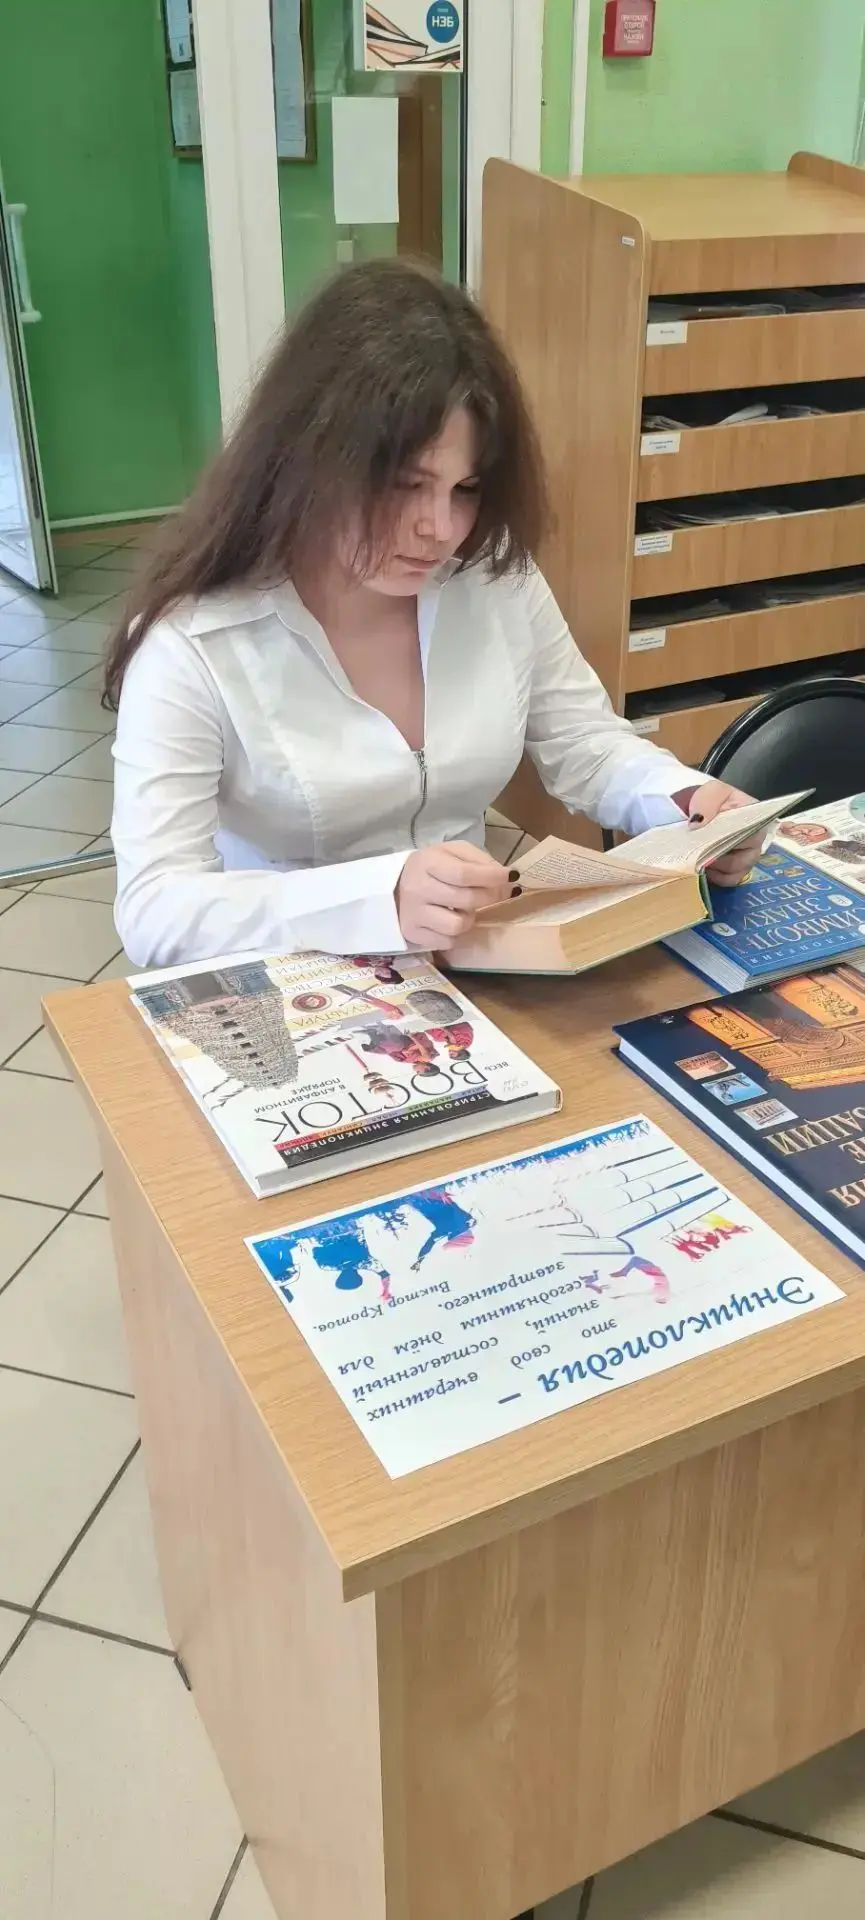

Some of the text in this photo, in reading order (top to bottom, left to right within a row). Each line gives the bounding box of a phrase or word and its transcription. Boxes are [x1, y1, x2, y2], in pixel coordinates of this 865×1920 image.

[432, 15, 454, 28] НЭБ
[371, 976, 432, 997] ЭТНОСЫ
[293, 1004, 370, 1027] КУЛЬТУРА
[290, 1077, 341, 1095] ПОРЯДКЕ
[484, 1061, 509, 1072] ВЕСЬ
[254, 1086, 336, 1114] АЛФАВИТНОМ
[255, 1061, 489, 1142] ВОСТОК
[283, 1091, 491, 1156] СТРИРОВАННАЯ ЭНЦИКЛОПЕДИЯ
[312, 1280, 451, 1333] Виктор Кротов.
[437, 1261, 566, 1312] завтрашнего.
[337, 1280, 582, 1377] сегодняшним днём для
[351, 1299, 600, 1403] знаний, составленный
[537, 1276, 815, 1393] Энциклопедия
[366, 1318, 618, 1422] это свод вчерашних
